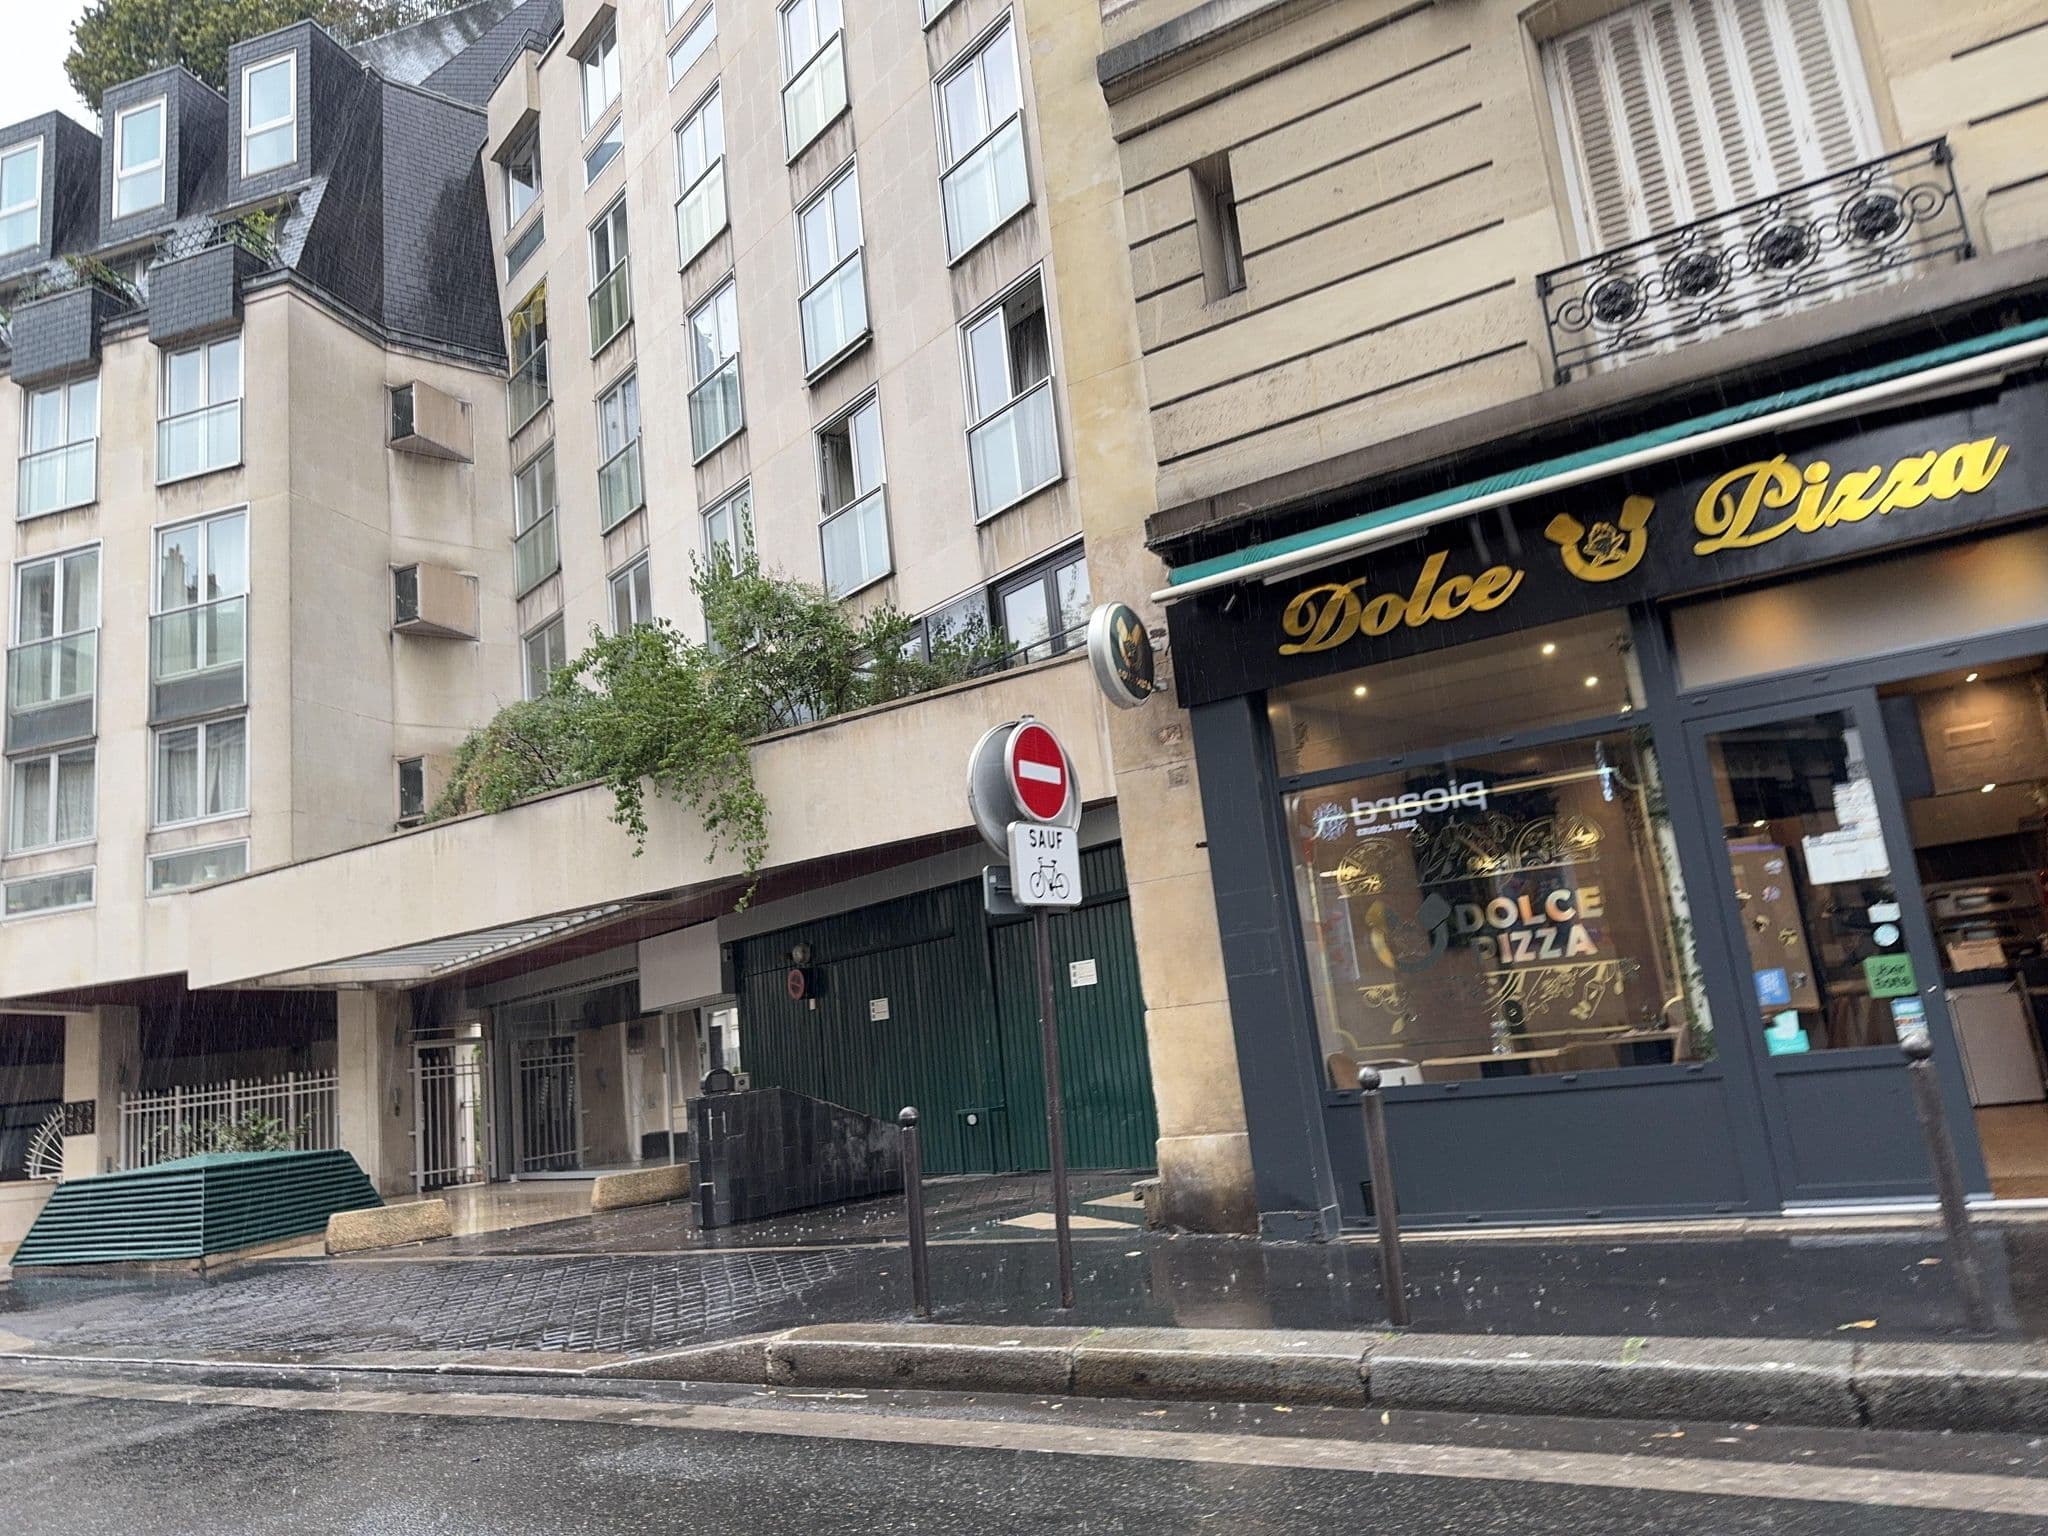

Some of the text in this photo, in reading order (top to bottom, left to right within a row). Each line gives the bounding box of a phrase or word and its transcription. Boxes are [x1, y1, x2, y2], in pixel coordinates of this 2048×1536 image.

[1278, 435, 2010, 656] Dolce Pizza
[1029, 829, 1063, 849] SAUF
[1455, 886, 1604, 934] DOLCE
[1471, 923, 1599, 964] PIZZA
